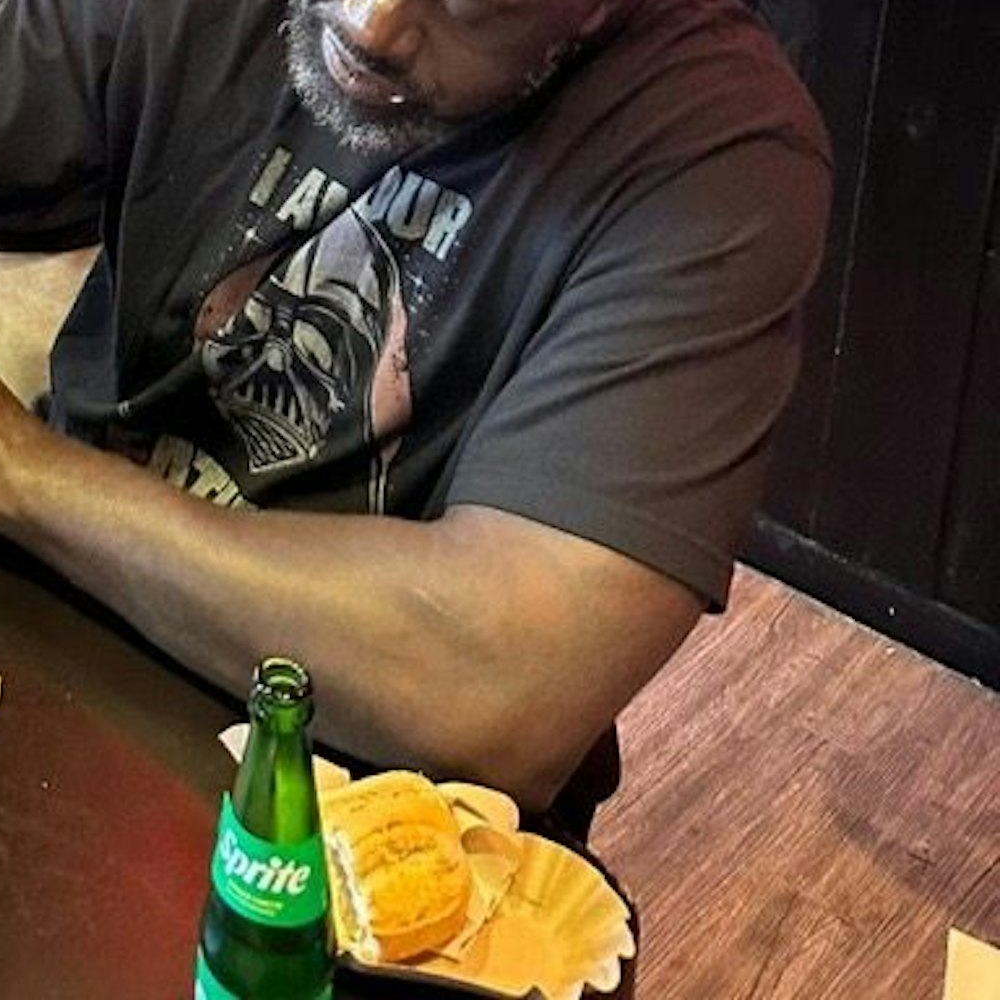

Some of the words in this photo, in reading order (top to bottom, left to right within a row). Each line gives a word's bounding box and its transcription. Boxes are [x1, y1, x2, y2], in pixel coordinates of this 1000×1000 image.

[250, 146, 292, 207] I
[351, 164, 473, 262] OUR
[220, 828, 311, 896] Sprite
